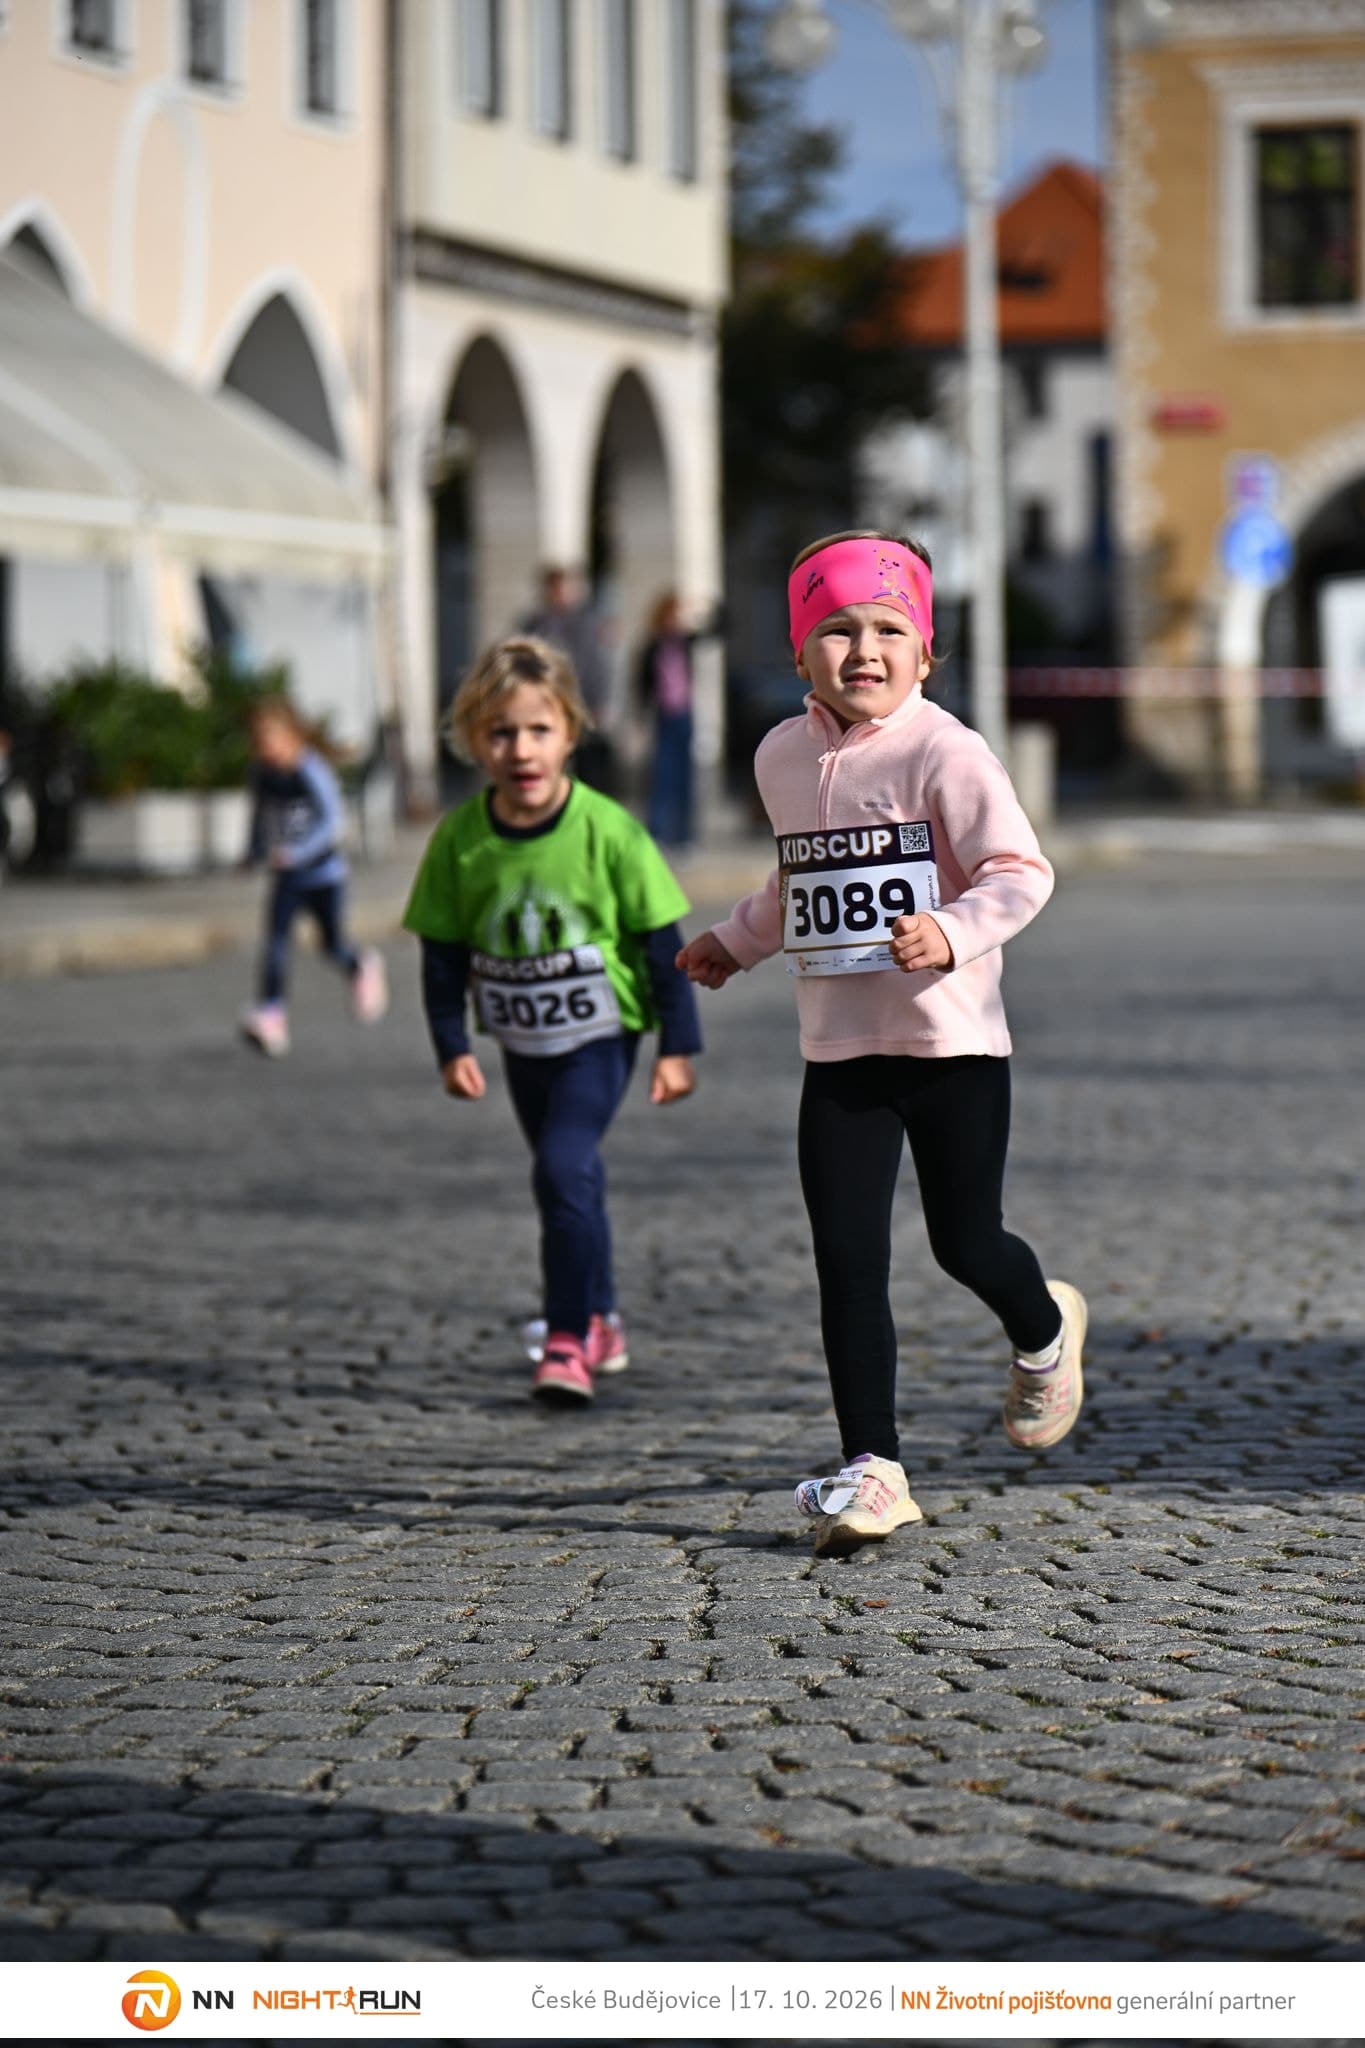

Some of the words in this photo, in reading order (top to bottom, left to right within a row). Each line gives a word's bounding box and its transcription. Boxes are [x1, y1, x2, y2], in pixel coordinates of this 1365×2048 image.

[782, 829, 893, 864] KIDSCUP
[791, 878, 915, 937] 3089
[487, 987, 596, 1028] 3026
